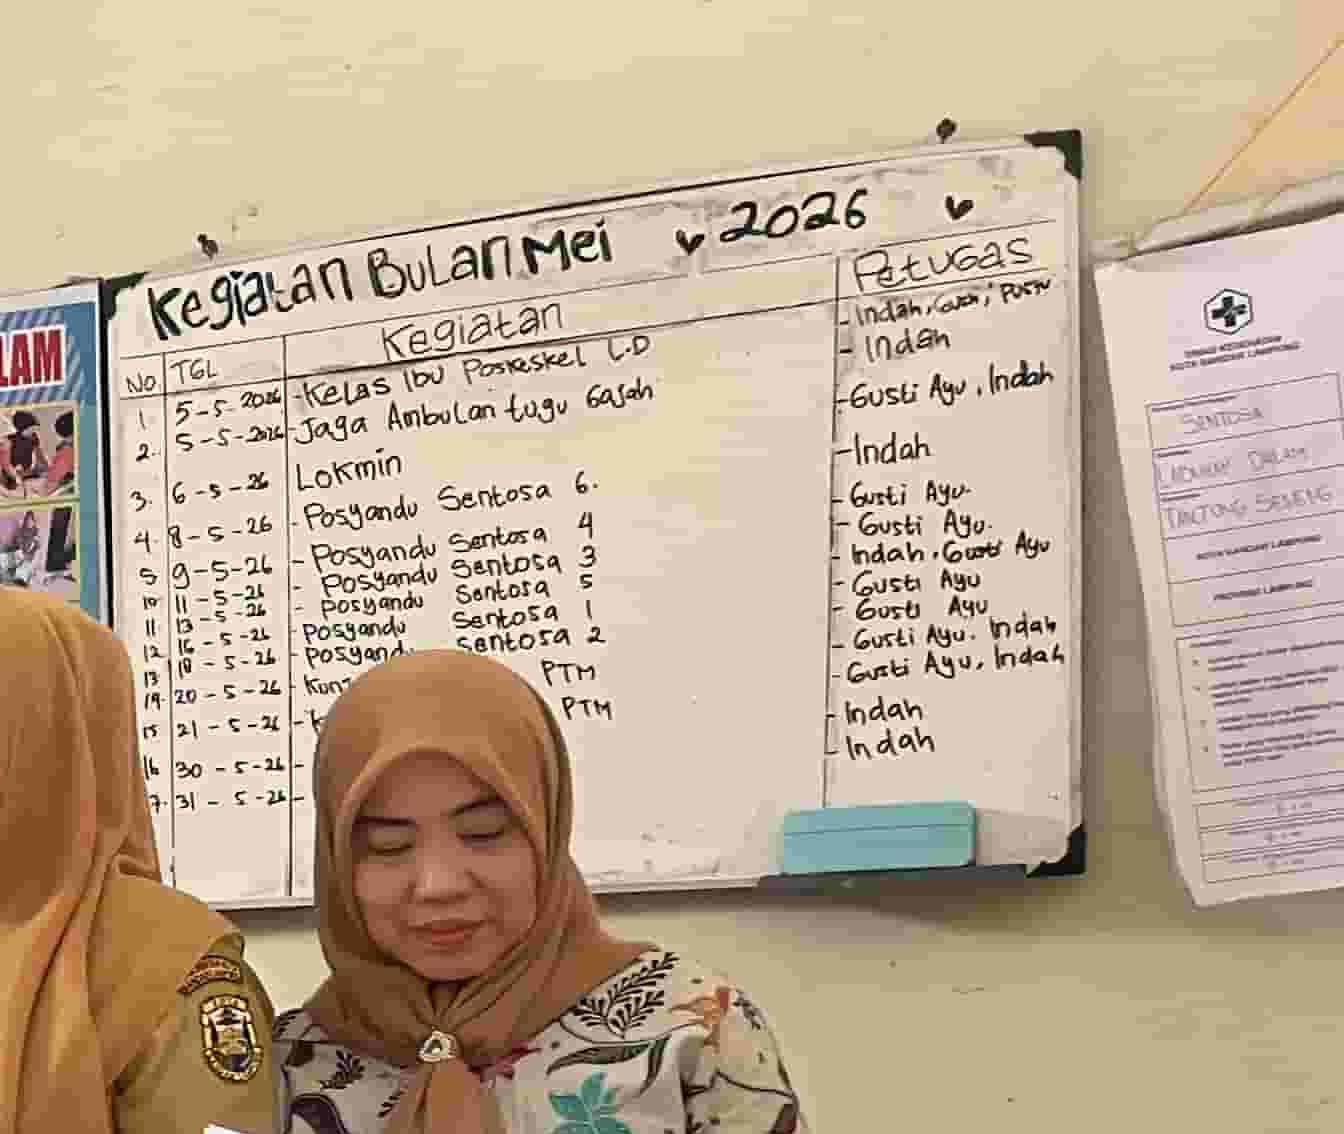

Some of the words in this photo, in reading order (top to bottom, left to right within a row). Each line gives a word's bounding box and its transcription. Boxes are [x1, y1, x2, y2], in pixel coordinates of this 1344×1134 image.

[147, 256, 353, 340] Kegiatan
[522, 221, 612, 275] Mei
[719, 189, 868, 242] 2026
[170, 358, 217, 384] TGL
[381, 302, 563, 361] Kegiatan
[303, 377, 391, 408] Kelas
[850, 383, 920, 409] Gusti
[989, 360, 1054, 395] Indah
[295, 415, 368, 444] Jaga
[387, 400, 497, 431] Ambulan
[504, 394, 568, 424] tugu
[854, 432, 930, 465] Indah
[303, 493, 418, 530] Posyandu
[437, 485, 553, 511] Sentosa
[850, 480, 907, 508] Gusti
[858, 512, 923, 536] Gusti
[311, 533, 436, 574] Posyandu
[448, 526, 548, 552] Sentosa
[578, 511, 593, 539] 4
[1015, 529, 1050, 559] Ayu
[321, 561, 437, 597] Posyandu
[451, 552, 562, 578] Sentosa
[578, 545, 597, 568] 3
[852, 569, 921, 596] Gusti
[941, 567, 980, 592] Ayu
[321, 592, 424, 618] Posyandu
[455, 581, 549, 604] Sentosa
[579, 574, 593, 590] 5
[855, 598, 920, 621] Gusti
[947, 595, 988, 618] Ayu
[303, 616, 406, 642] Posyandu
[452, 604, 559, 629] Sentosa
[588, 627, 606, 643] 2
[853, 627, 915, 649] Gusti
[989, 610, 1057, 640] Indah
[541, 659, 596, 687] PTM
[847, 658, 910, 684] Gusti
[994, 642, 1064, 670] Indah
[562, 695, 613, 721] PTM
[845, 696, 923, 725] Indah
[846, 727, 936, 760] Indah
